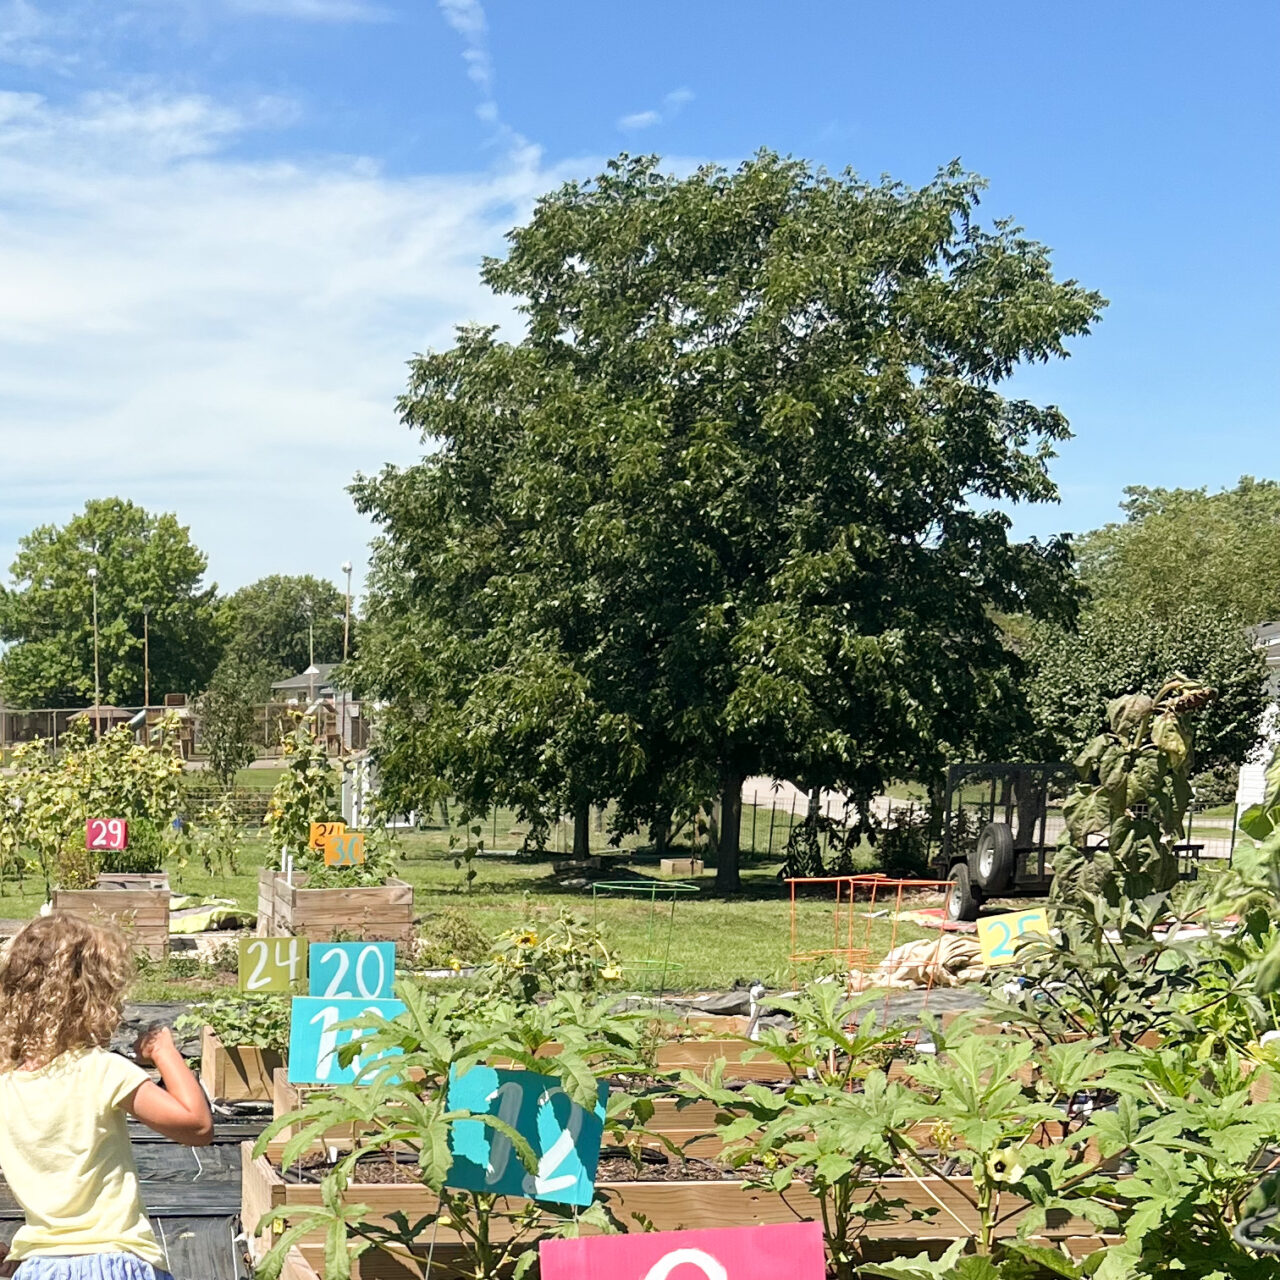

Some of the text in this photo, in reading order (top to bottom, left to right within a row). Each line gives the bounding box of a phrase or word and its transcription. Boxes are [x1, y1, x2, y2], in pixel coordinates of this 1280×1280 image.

[92, 820, 122, 847] 29
[247, 939, 301, 990] 24
[320, 945, 384, 999] 20
[485, 1082, 583, 1195] 12
